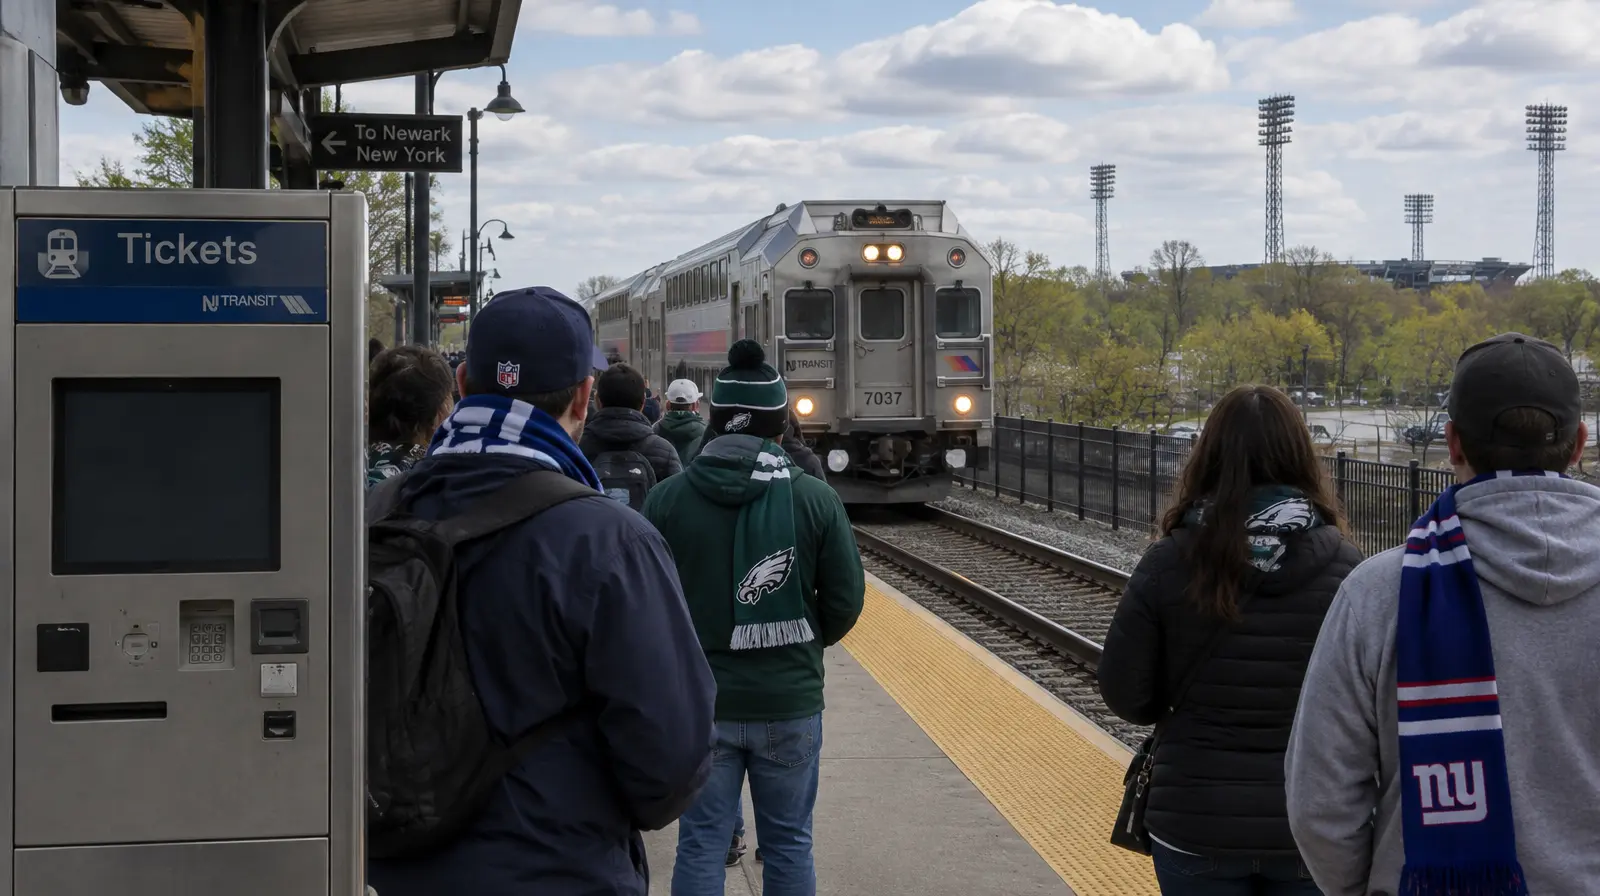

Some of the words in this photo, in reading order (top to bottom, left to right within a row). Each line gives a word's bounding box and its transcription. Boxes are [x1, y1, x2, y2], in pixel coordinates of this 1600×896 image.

[354, 124, 377, 140] To
[383, 125, 452, 142] Newark
[356, 146, 398, 161] New
[403, 146, 446, 163] York
[117, 232, 258, 264] Tickets
[202, 295, 219, 312] NJ
[221, 295, 277, 306] TRANSIT
[798, 360, 833, 368] TRANSIT
[864, 392, 902, 405] 7037
[1412, 760, 1488, 825] ny
